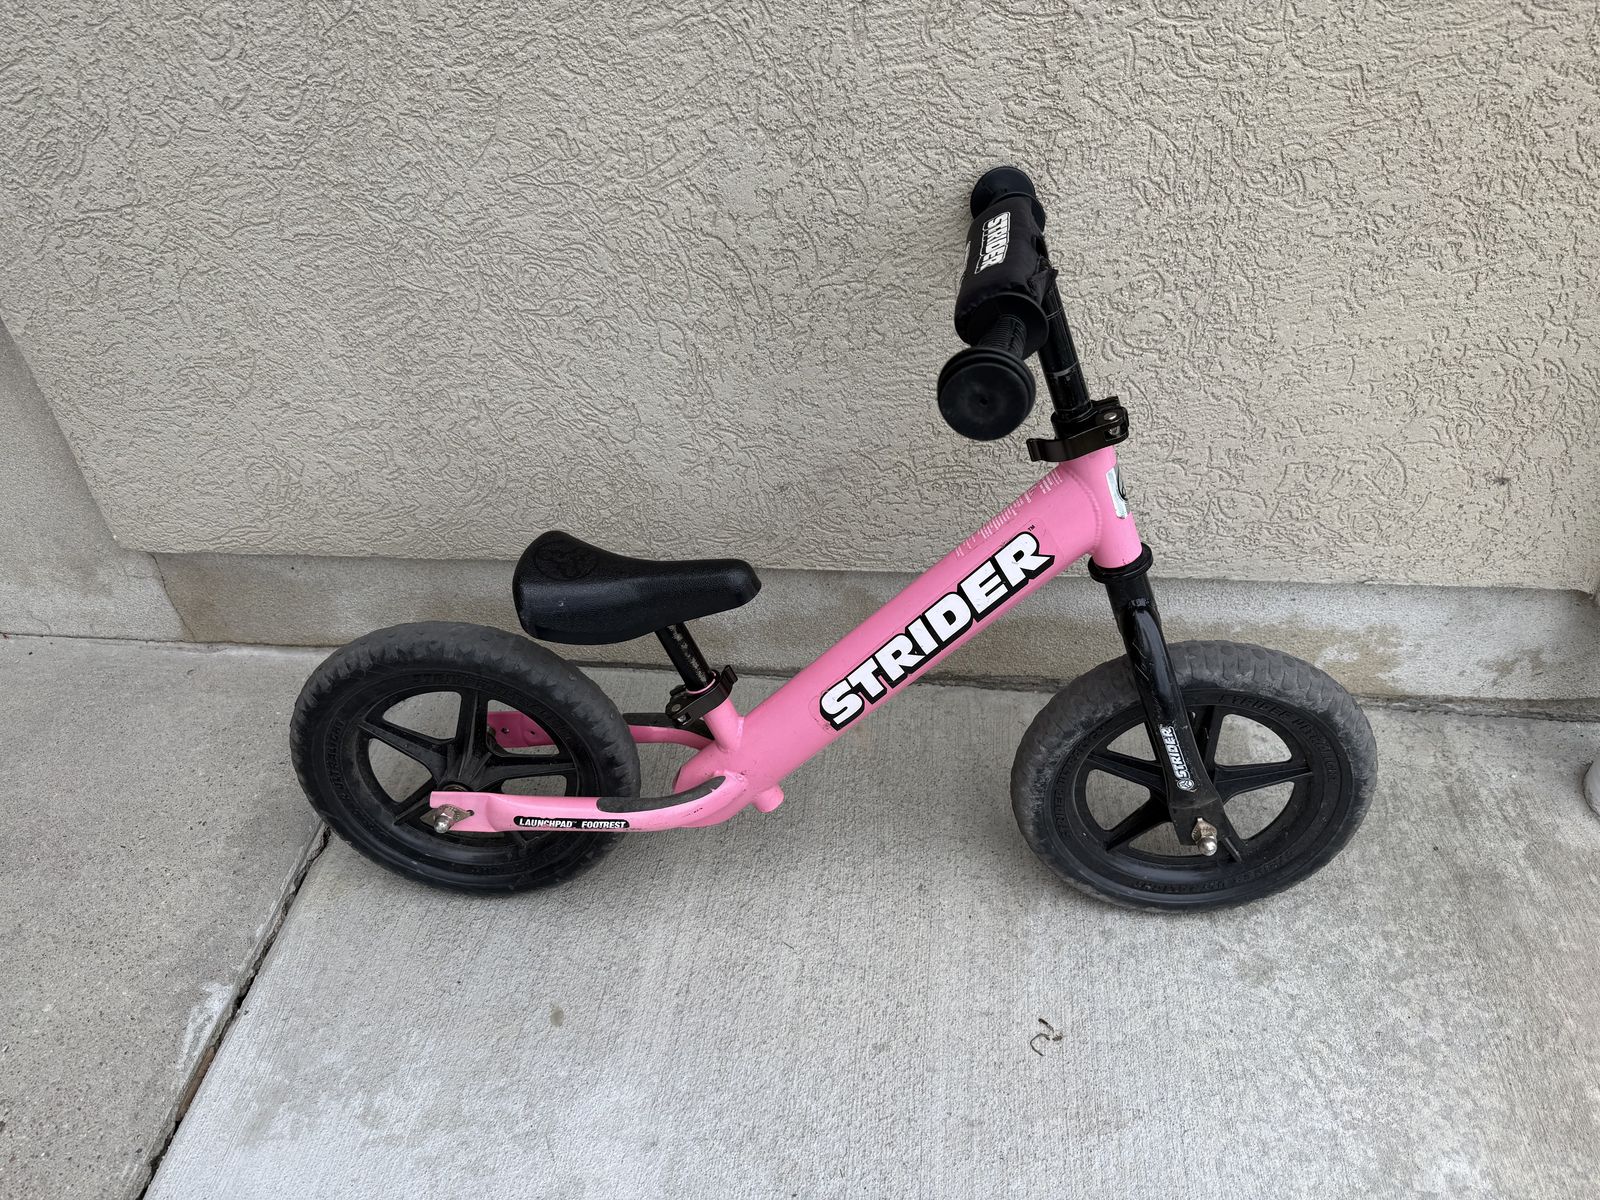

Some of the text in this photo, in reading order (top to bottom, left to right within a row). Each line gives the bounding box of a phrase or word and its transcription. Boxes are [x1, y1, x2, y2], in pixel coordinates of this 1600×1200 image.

[975, 212, 1011, 274] STRIDER
[1160, 725, 1191, 779] STRIDER
[581, 820, 627, 829] FOOTREST
